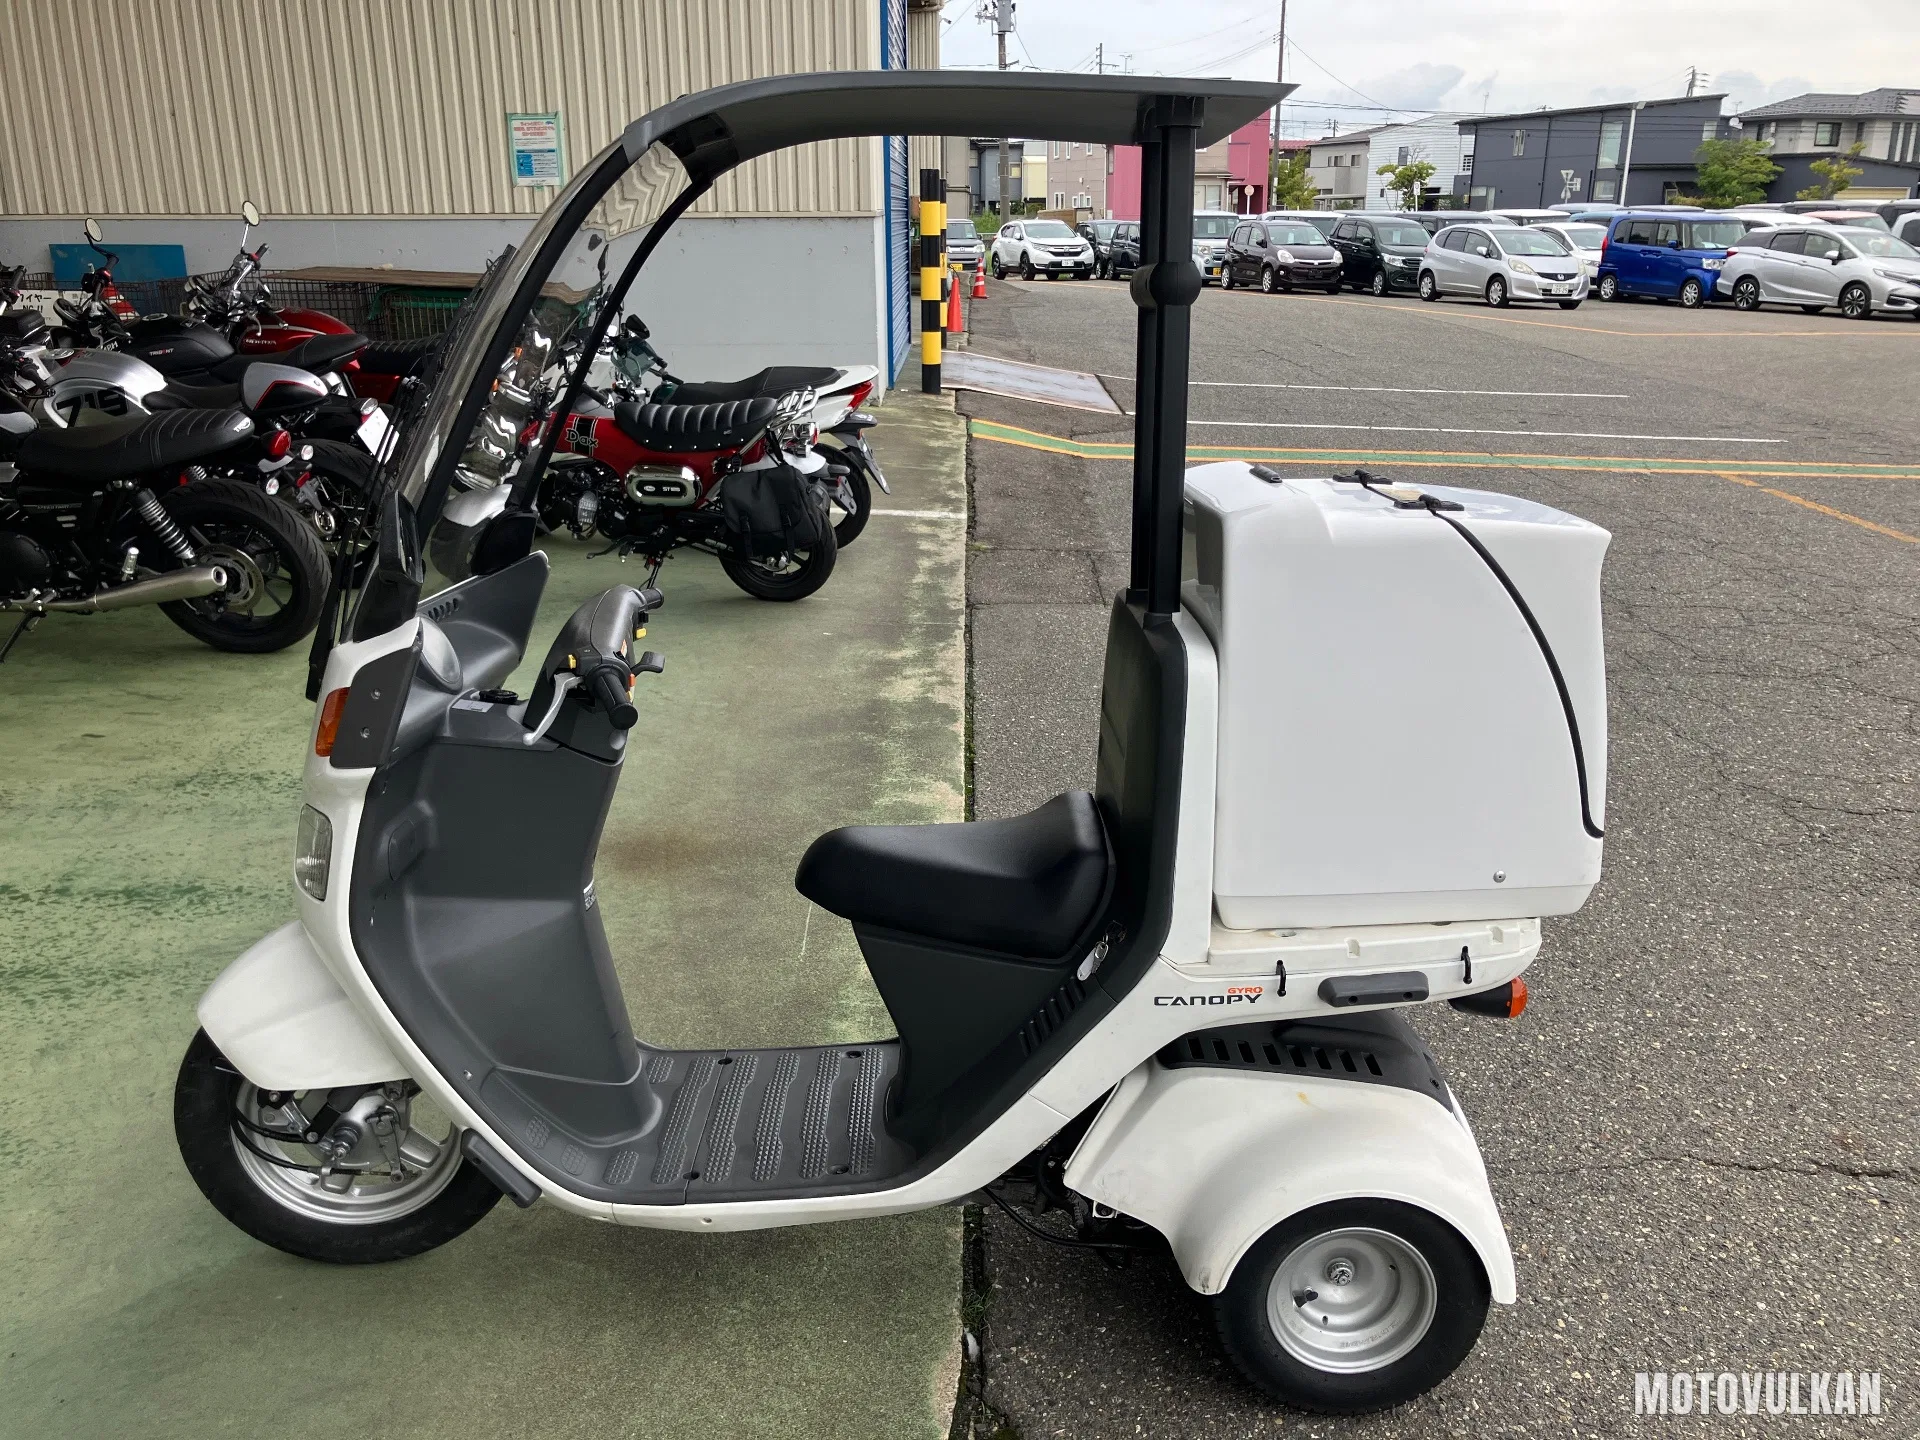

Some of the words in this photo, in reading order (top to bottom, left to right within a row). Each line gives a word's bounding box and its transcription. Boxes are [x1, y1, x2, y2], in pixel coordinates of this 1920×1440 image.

[565, 428, 599, 448] Dax
[1227, 986, 1263, 994] GYRO
[1154, 994, 1263, 1006] CANOPY
